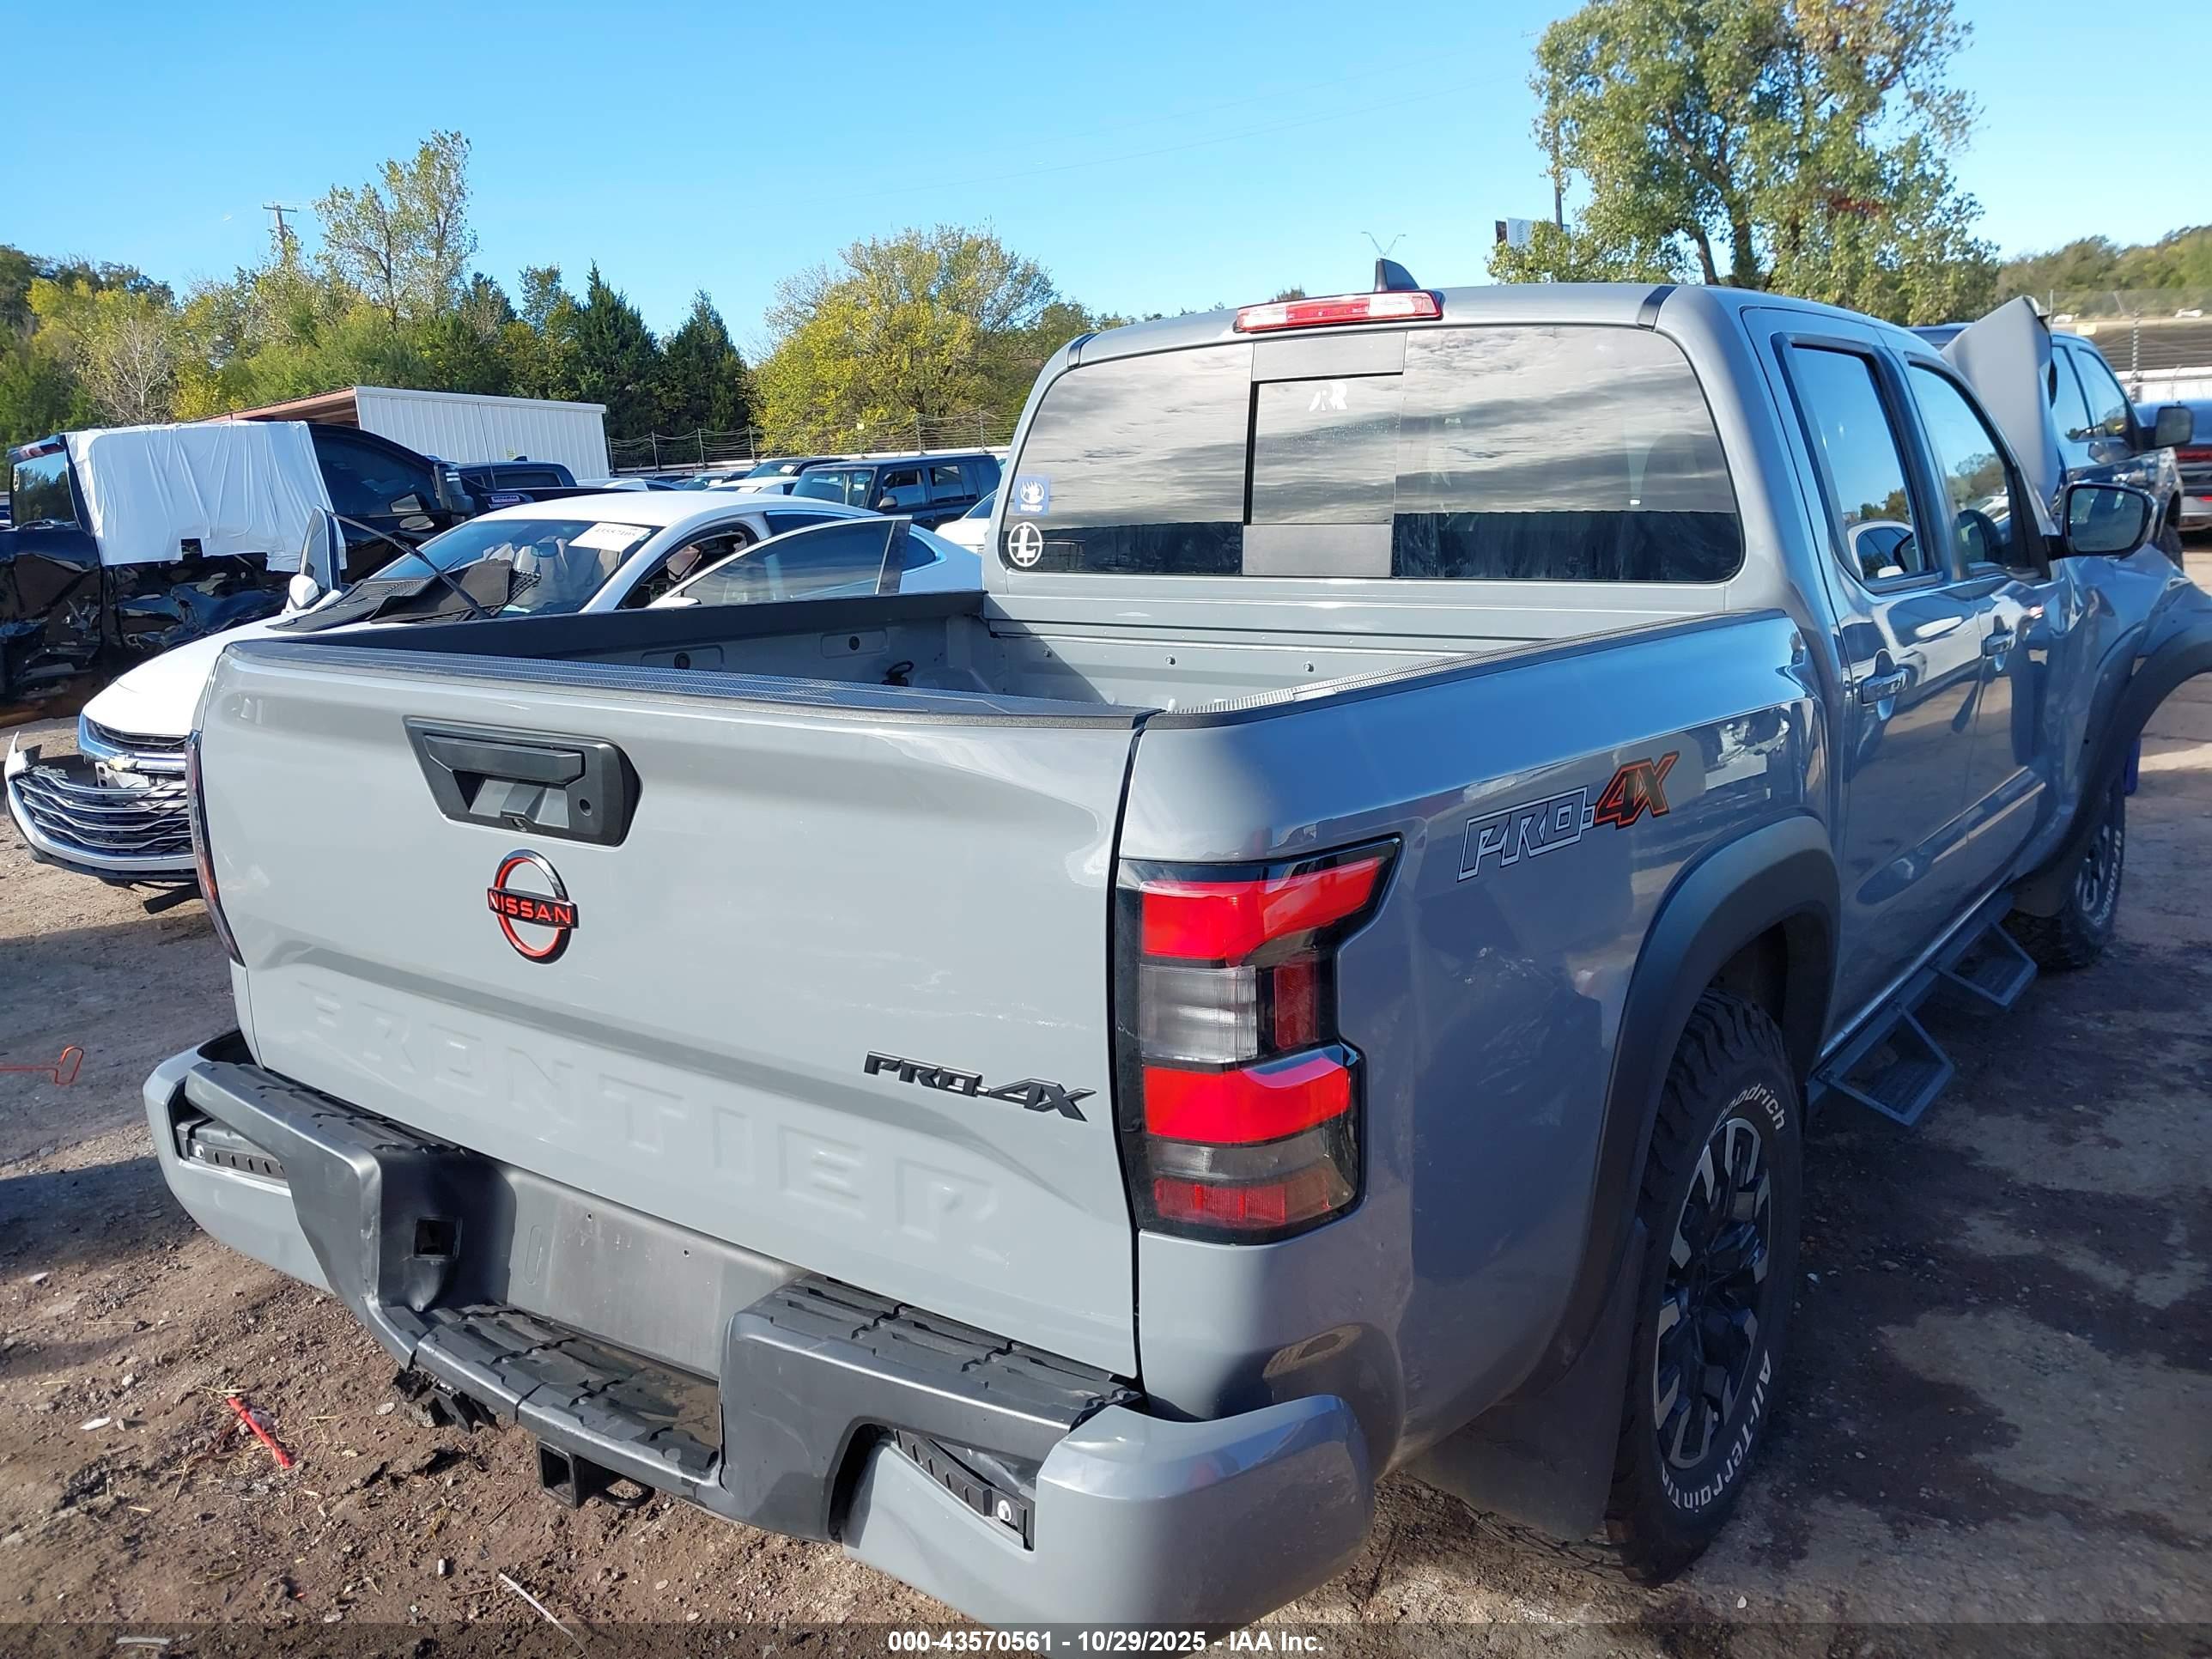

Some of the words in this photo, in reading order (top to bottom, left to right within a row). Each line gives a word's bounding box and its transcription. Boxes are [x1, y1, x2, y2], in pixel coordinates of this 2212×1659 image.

[489, 890, 572, 925] NISSAN
[295, 980, 1008, 1266] FRONTIER
[863, 1050, 1098, 1123] PRO-4X
